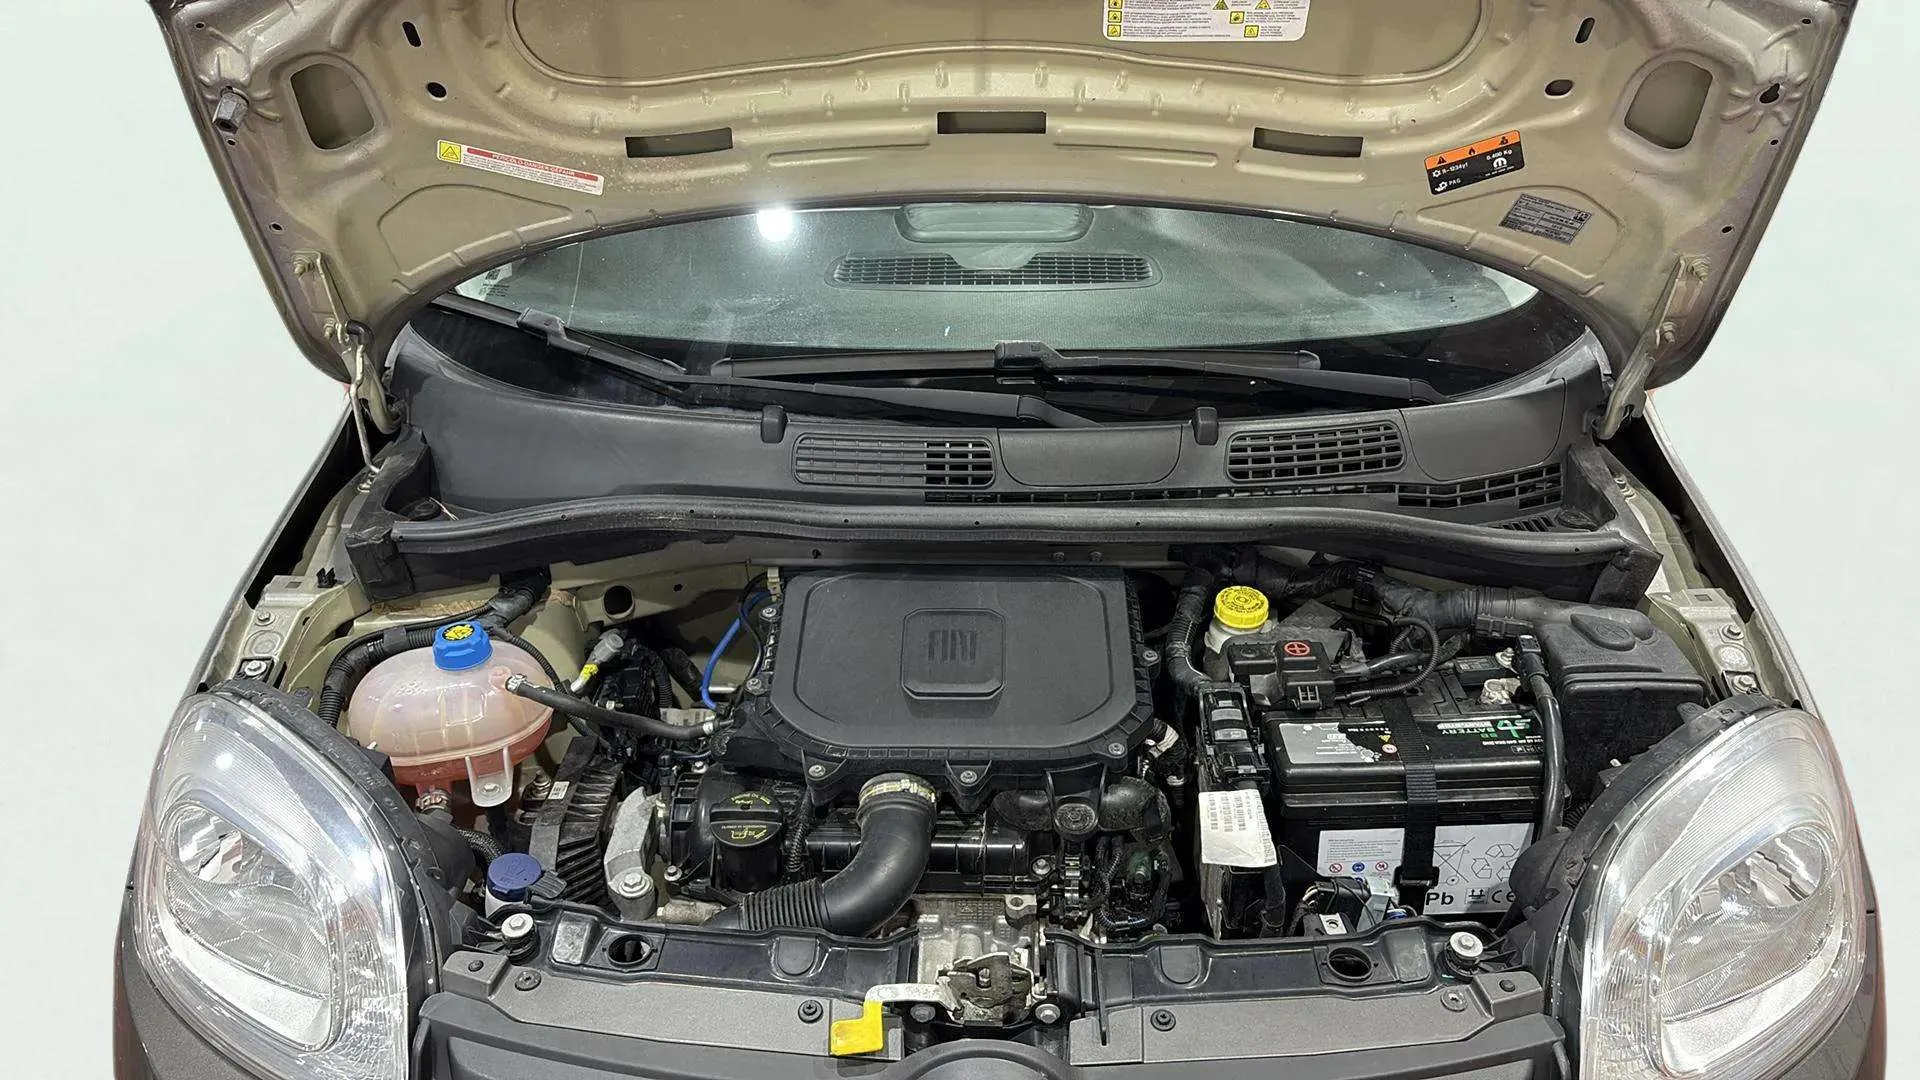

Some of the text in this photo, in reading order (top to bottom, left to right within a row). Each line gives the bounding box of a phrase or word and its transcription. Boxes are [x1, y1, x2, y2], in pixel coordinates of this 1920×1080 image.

[1448, 177, 1462, 186] PAG
[928, 629, 979, 661] FIAT
[1442, 727, 1496, 735] BATTERY
[1425, 892, 1454, 906] Pb
